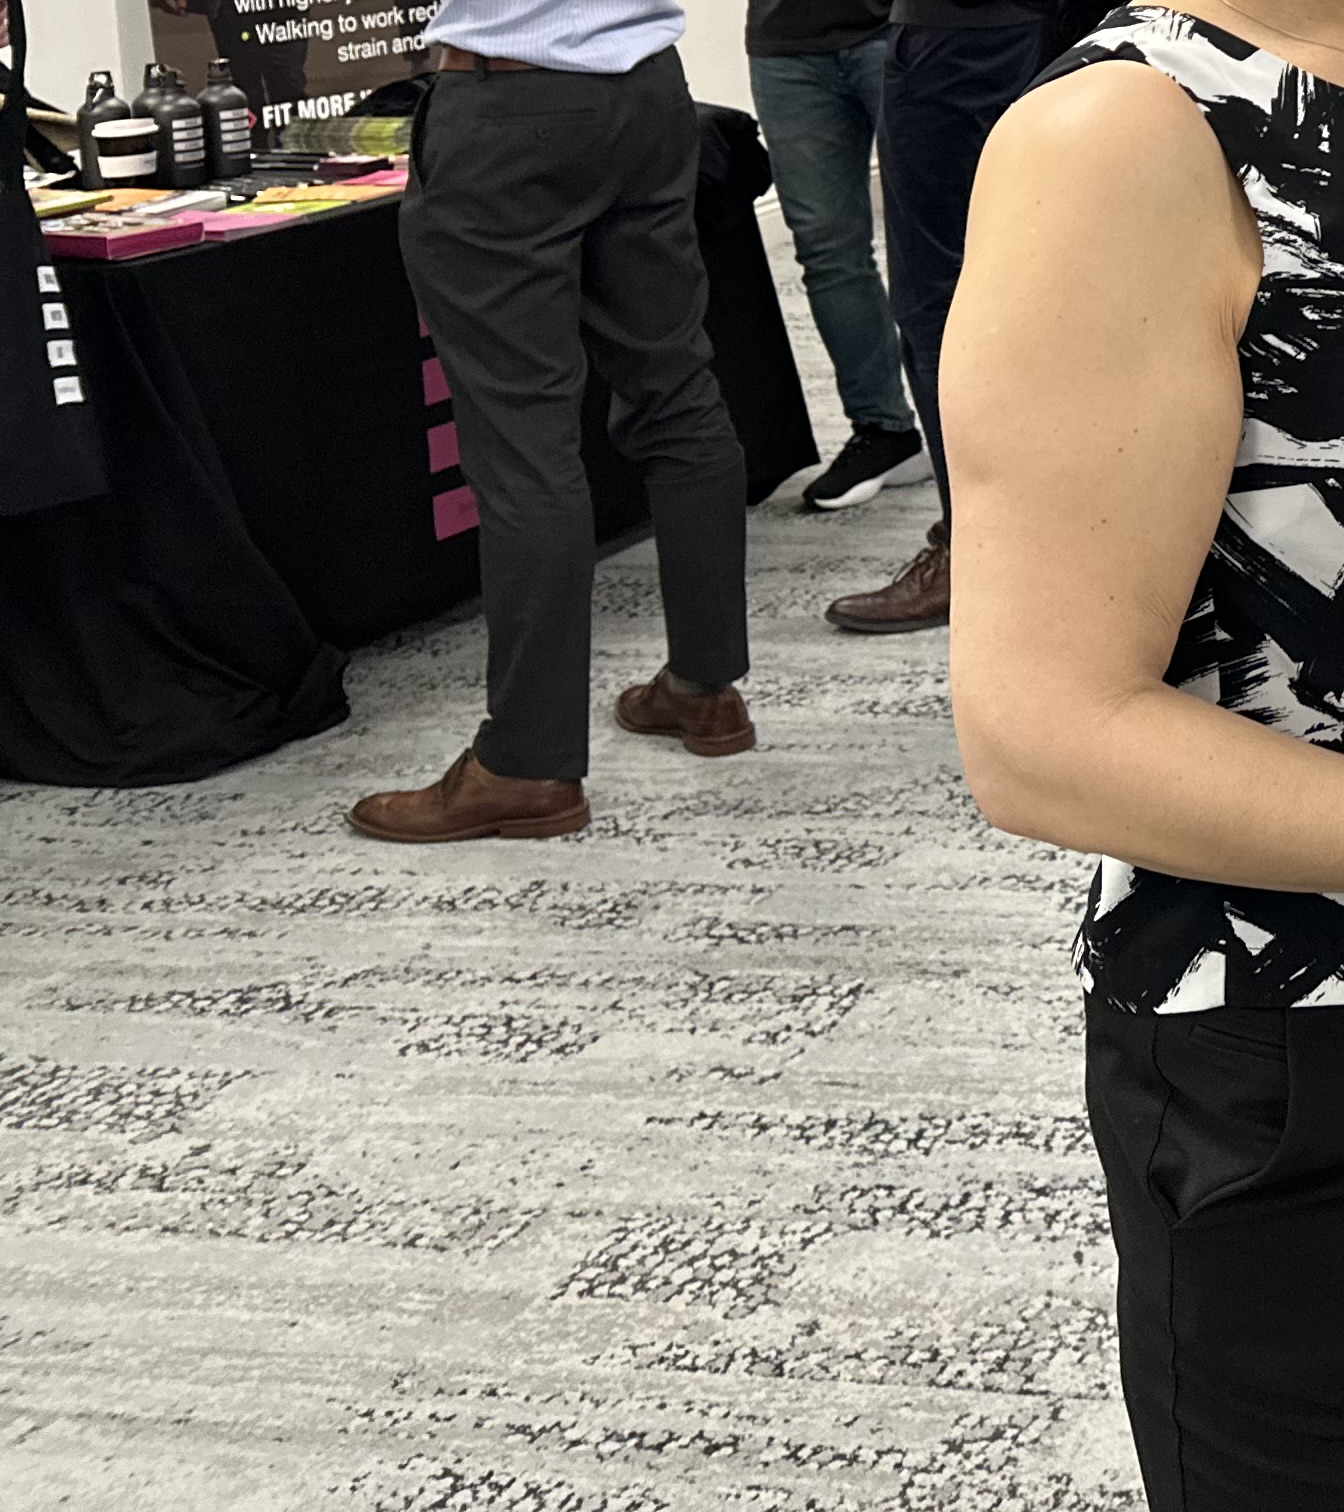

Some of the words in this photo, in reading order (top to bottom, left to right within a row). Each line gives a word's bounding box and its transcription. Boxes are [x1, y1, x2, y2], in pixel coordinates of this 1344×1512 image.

[256, 17, 333, 44] Walking
[338, 15, 357, 33] to
[362, 8, 405, 30] work
[338, 38, 388, 62] strain
[392, 34, 424, 54] and
[263, 103, 292, 128] FIT
